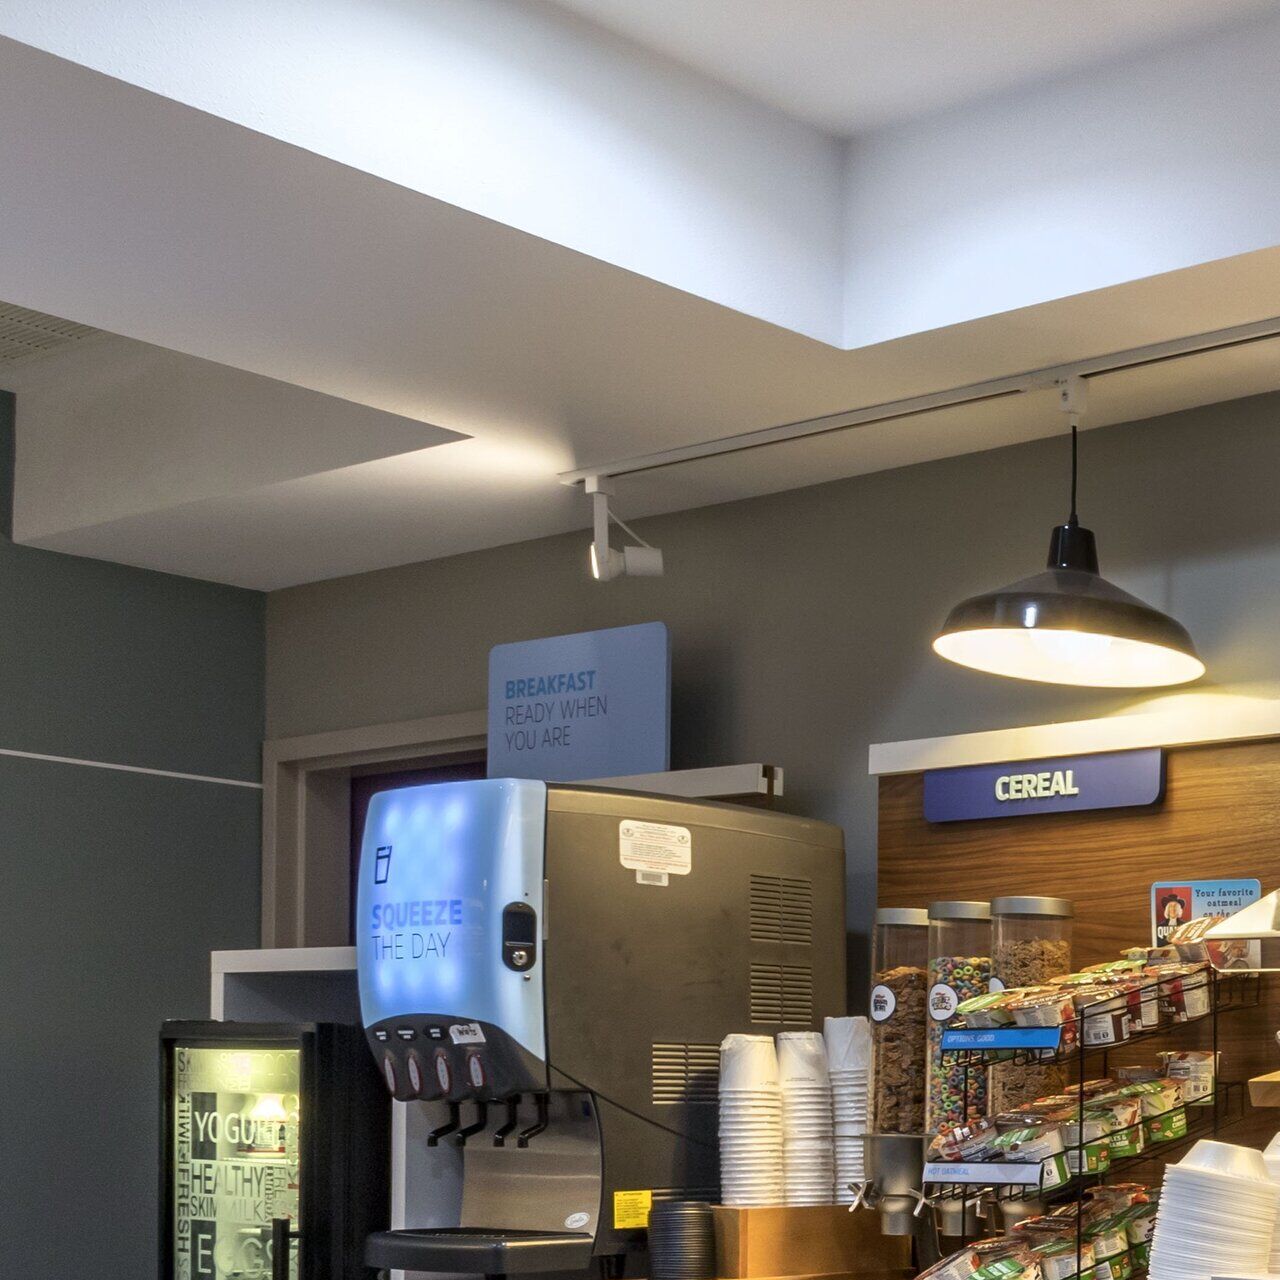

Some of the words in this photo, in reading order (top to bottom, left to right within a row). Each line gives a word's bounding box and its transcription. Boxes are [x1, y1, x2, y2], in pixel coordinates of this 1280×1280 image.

[505, 670, 597, 699] BREAKFAST
[505, 702, 555, 726] READY
[560, 695, 608, 720] WHEN
[505, 730, 537, 752] YOU
[541, 726, 571, 748] ARE
[995, 770, 1080, 801] CEREAL
[1195, 889, 1215, 898] Your
[1218, 888, 1254, 897] favorite
[1207, 898, 1242, 907] oatmeal
[371, 900, 462, 931] SQUEEZE
[371, 934, 404, 960] THE
[412, 931, 451, 959] DAY
[191, 1163, 265, 1198] HEALTHY
[178, 1168, 190, 1253] FRESH
